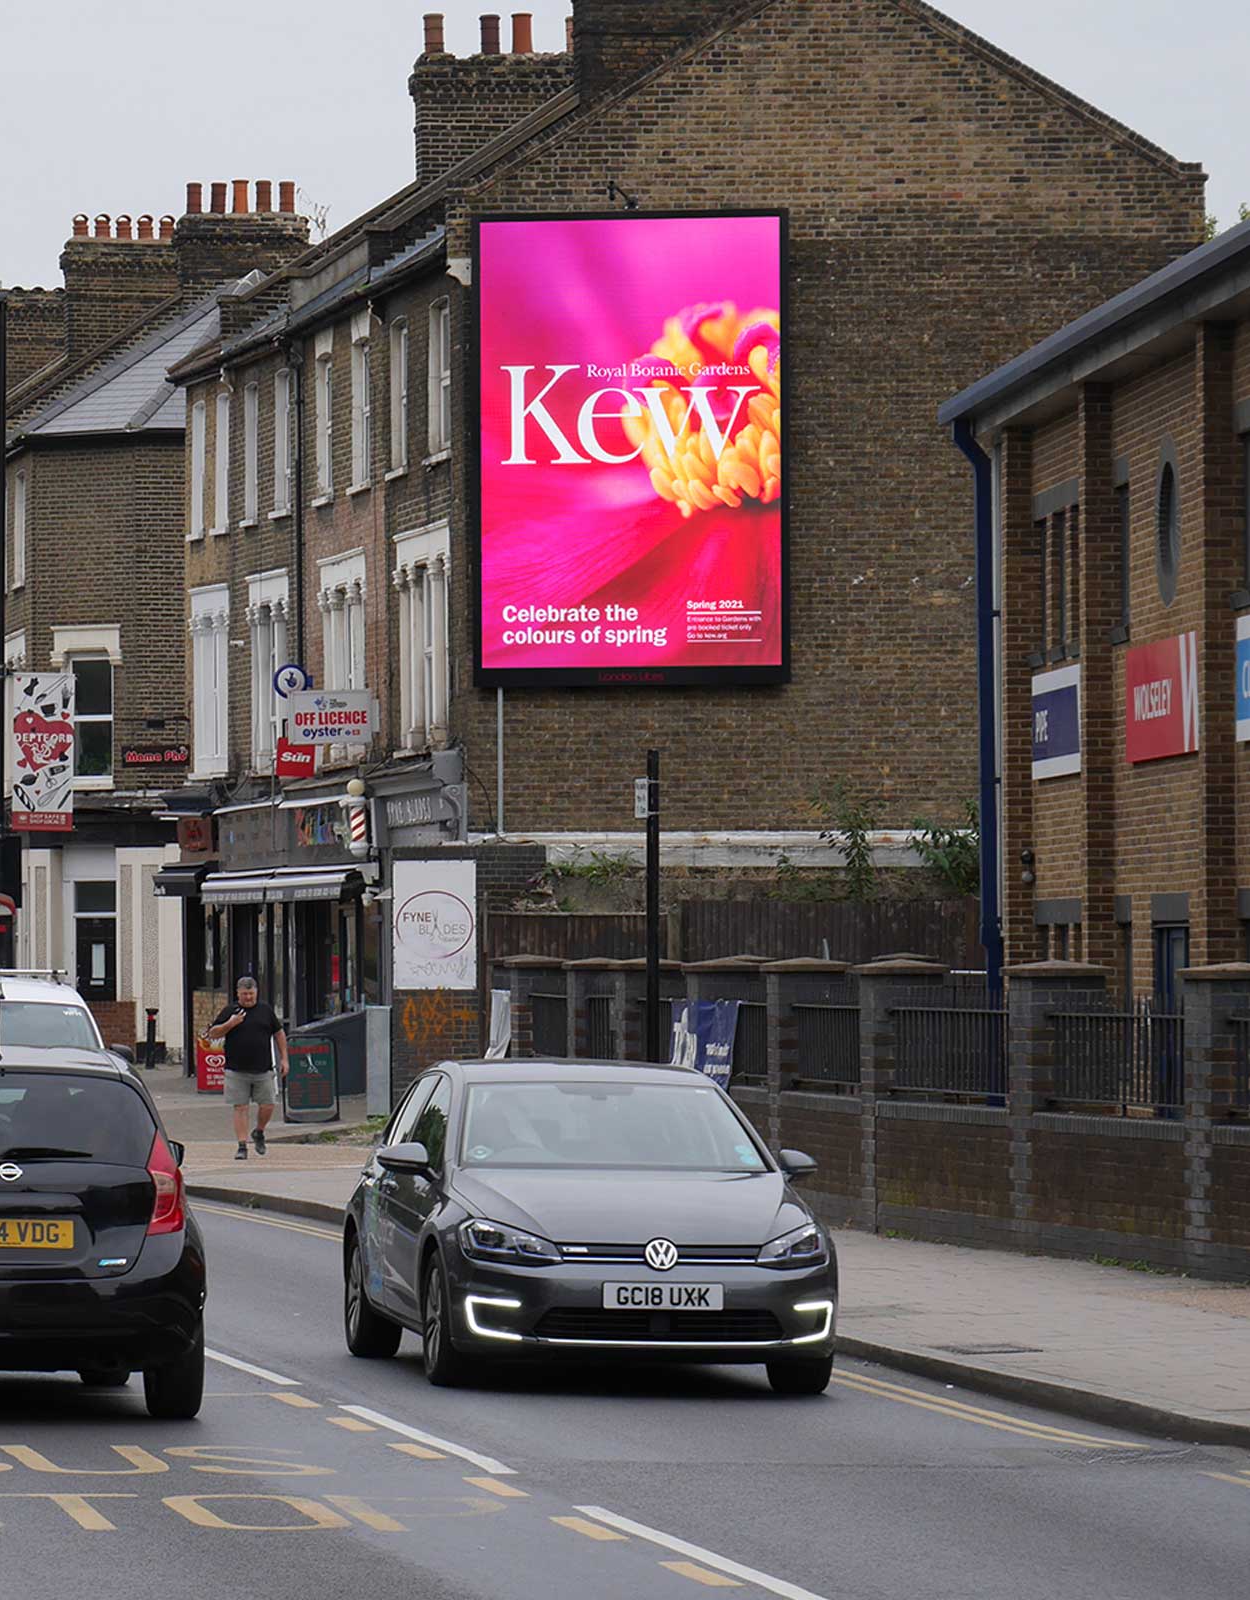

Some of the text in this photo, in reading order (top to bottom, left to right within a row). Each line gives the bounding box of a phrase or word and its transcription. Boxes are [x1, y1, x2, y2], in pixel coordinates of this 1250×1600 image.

[586, 361, 751, 382] Royal Botanic Gardens
[499, 363, 762, 466] Kew
[501, 603, 639, 623] Celebrate the
[686, 599, 744, 611] Spring 2021
[501, 625, 668, 647] colours of spring
[1133, 678, 1173, 721] WOLSELEY
[294, 710, 368, 727] OFF LICENCE
[13, 732, 74, 744] DEPTFORD
[302, 726, 343, 740] oyster
[125, 750, 162, 763] Mama
[280, 751, 311, 763] Sun
[402, 911, 432, 923] FYNE
[16, 1221, 61, 1244] VDG
[616, 1286, 711, 1308] GC18 UXK
